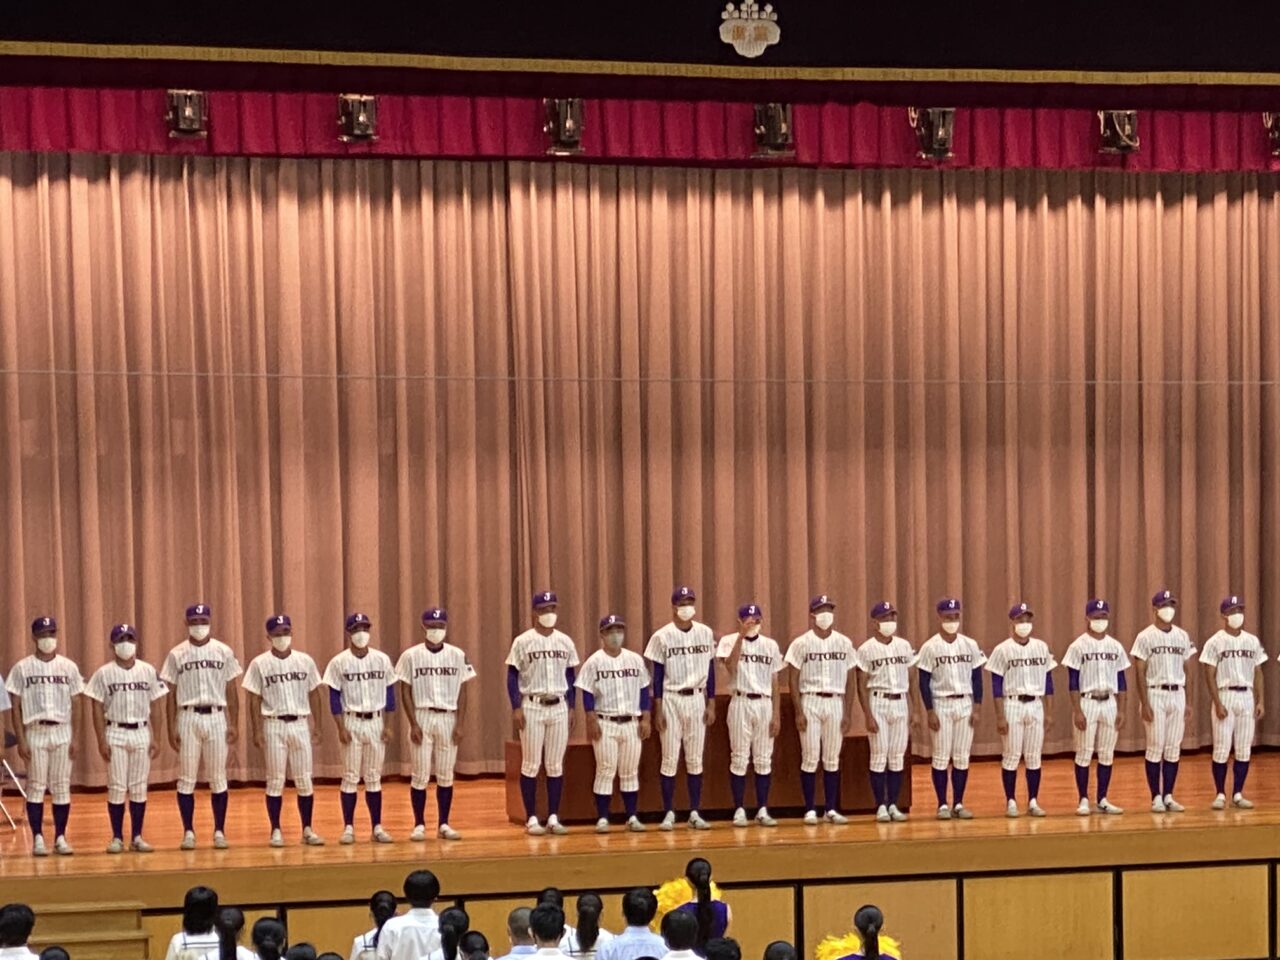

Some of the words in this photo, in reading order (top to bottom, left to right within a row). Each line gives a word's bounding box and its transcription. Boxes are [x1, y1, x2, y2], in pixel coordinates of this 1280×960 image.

[544, 592, 551, 601] J
[196, 605, 204, 614] J
[949, 600, 956, 608] J
[1096, 600, 1104, 609] J
[433, 610, 441, 618] J
[748, 606, 756, 614] J
[609, 615, 616, 623] J
[527, 650, 568, 663] JUTOKU
[667, 645, 710, 658] JUTOKU
[803, 652, 847, 663] JUTOKU
[935, 655, 973, 667] JUTOKU
[1006, 657, 1047, 669] JUTOKU
[178, 660, 224, 674] JUTOKU
[414, 667, 457, 679] JUTOKU
[595, 669, 640, 681] JUTOKU
